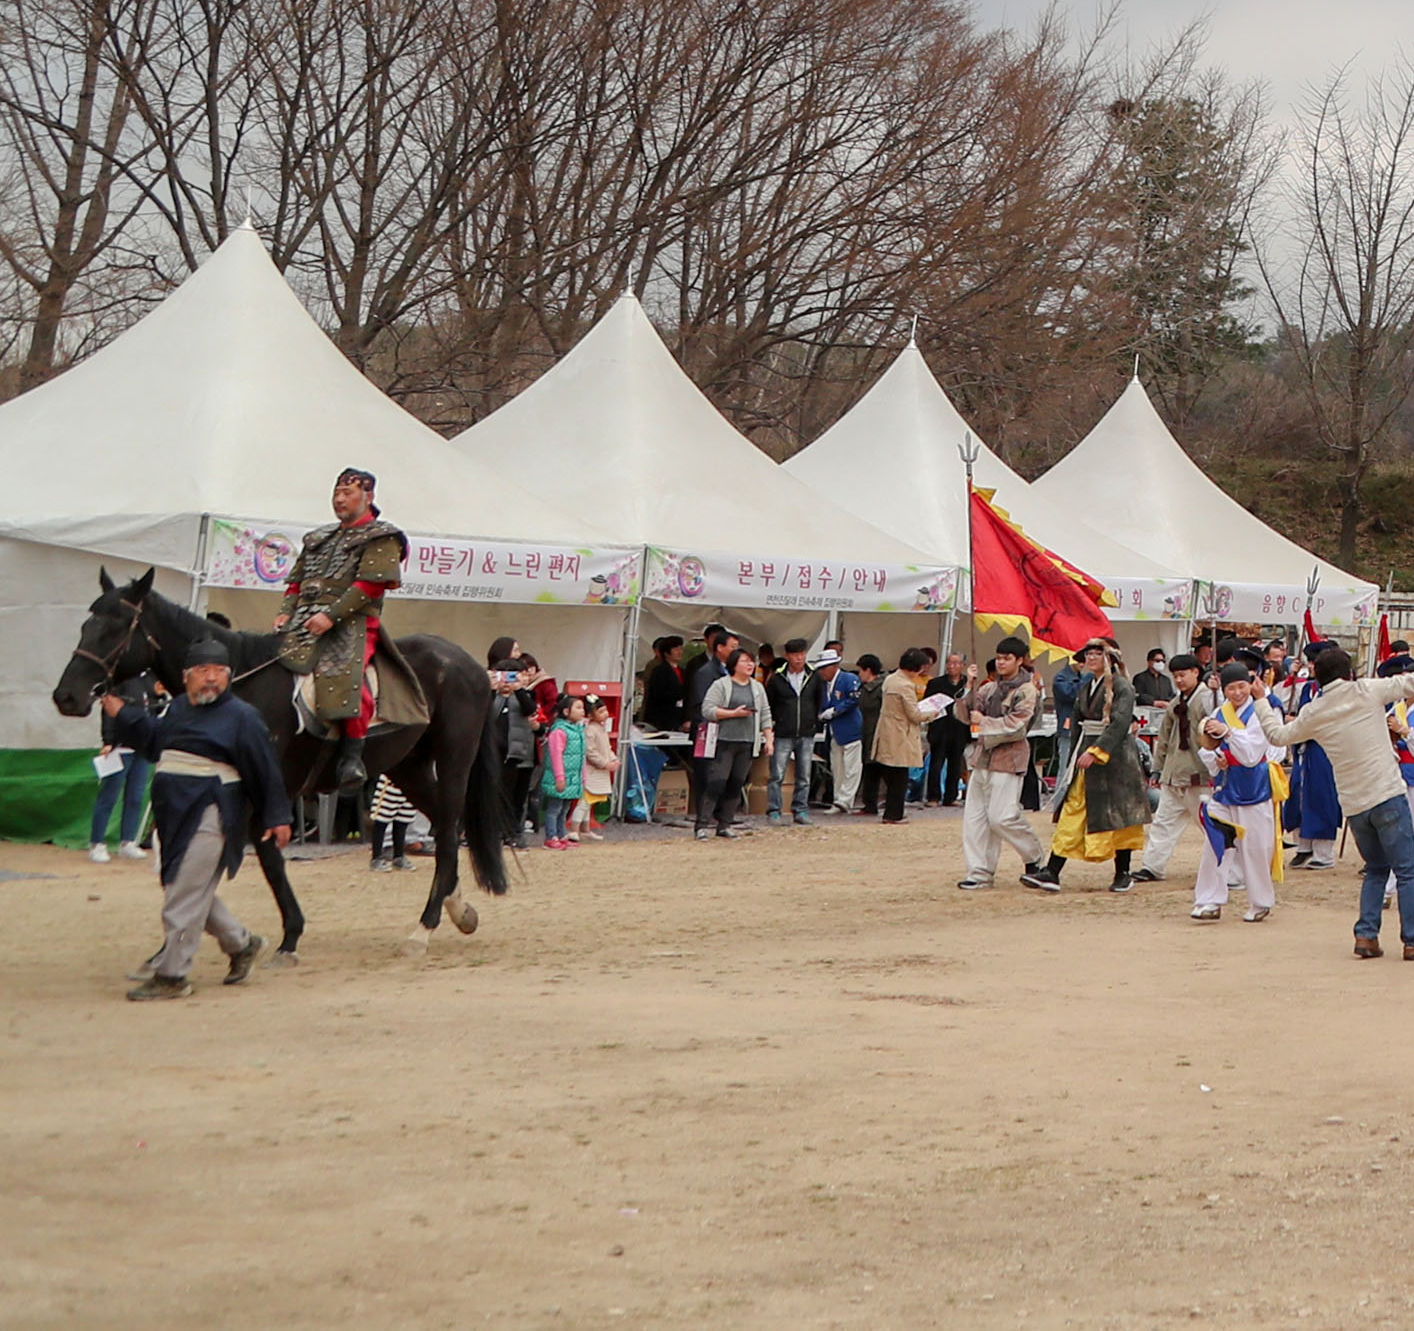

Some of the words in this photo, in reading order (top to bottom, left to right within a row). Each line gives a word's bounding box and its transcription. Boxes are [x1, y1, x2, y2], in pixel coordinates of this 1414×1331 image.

[418, 545, 474, 577] 만들기
[482, 551, 498, 574] &
[504, 552, 541, 580] 느린
[547, 554, 581, 583] 편지
